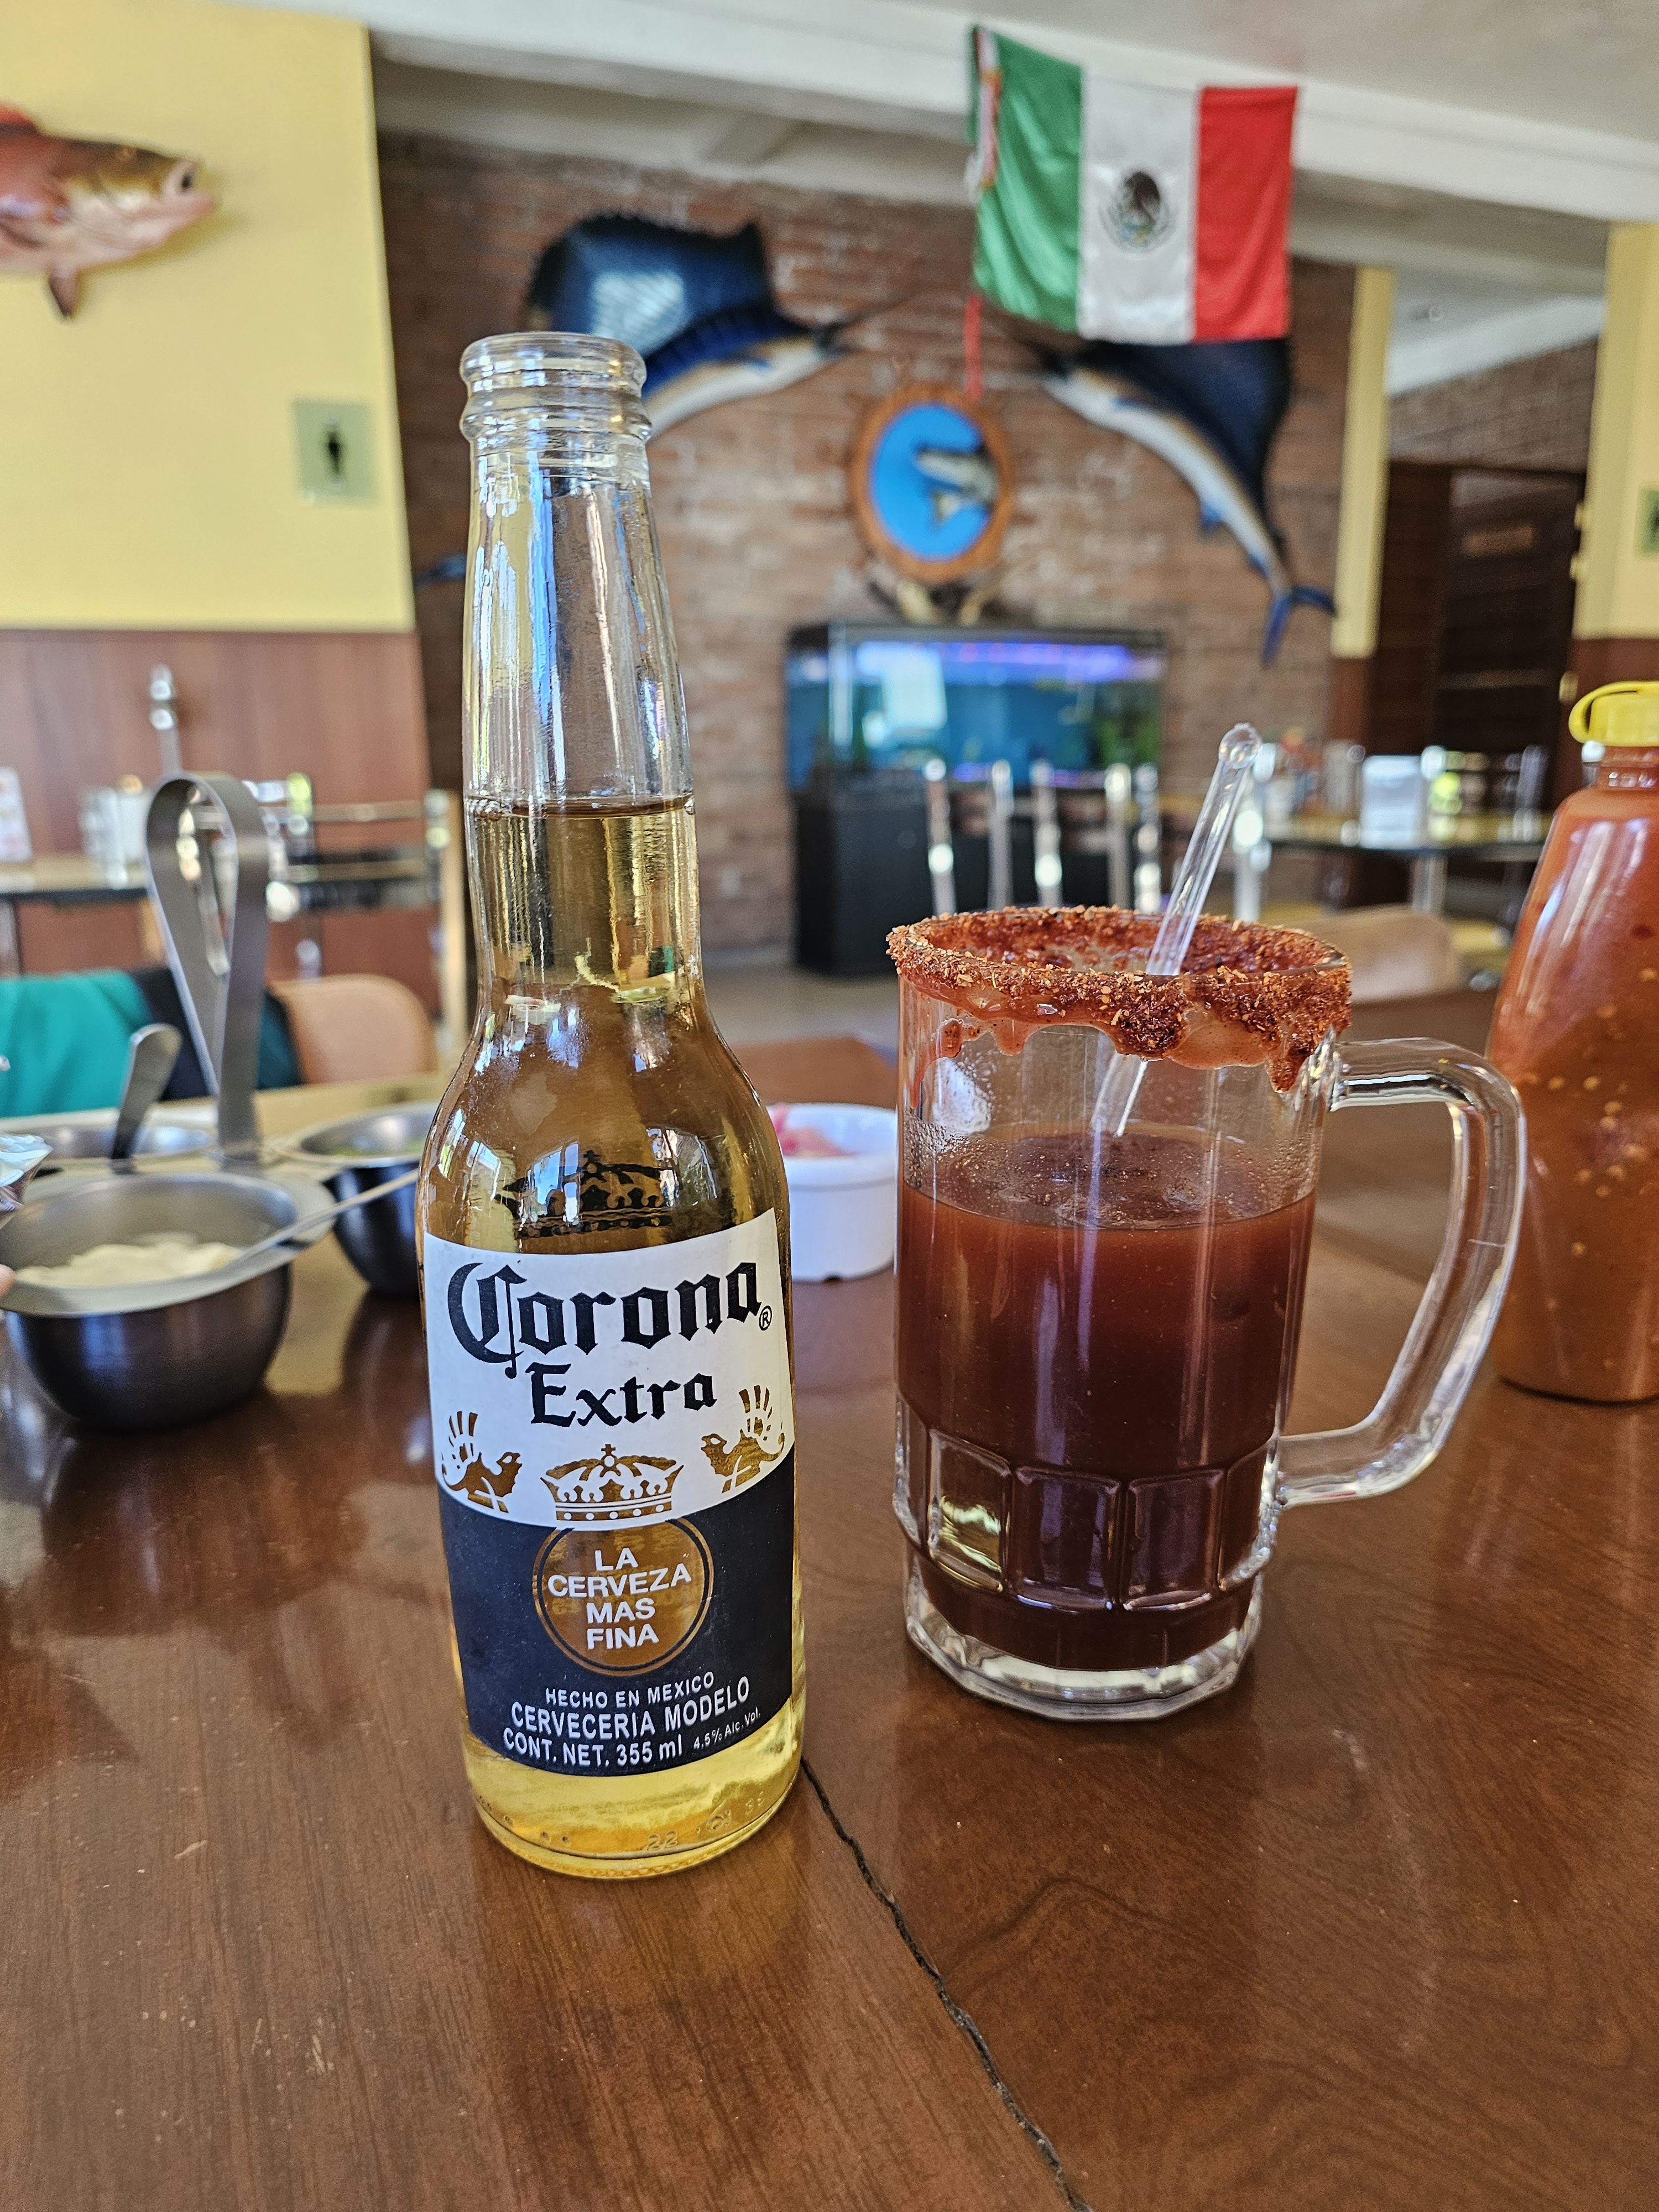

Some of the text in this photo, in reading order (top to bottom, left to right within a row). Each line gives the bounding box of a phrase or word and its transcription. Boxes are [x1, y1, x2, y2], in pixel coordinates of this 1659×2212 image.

[447, 1262, 762, 1379] Corona
[525, 1361, 717, 1428] Extra
[594, 1547, 638, 1572] LA
[547, 1563, 692, 1598] CERVEZA
[586, 1598, 656, 1624] MAS
[587, 1623, 659, 1650] FINA
[512, 1676, 750, 1739] CERVECERIA MODELO
[545, 1671, 714, 1709] HECHO EN MEXICO
[503, 1728, 557, 1762] CONT.
[563, 1742, 609, 1767] NET.
[617, 1742, 653, 1766] 355
[660, 1734, 682, 1759] ml
[693, 1727, 722, 1750] 4.5%
